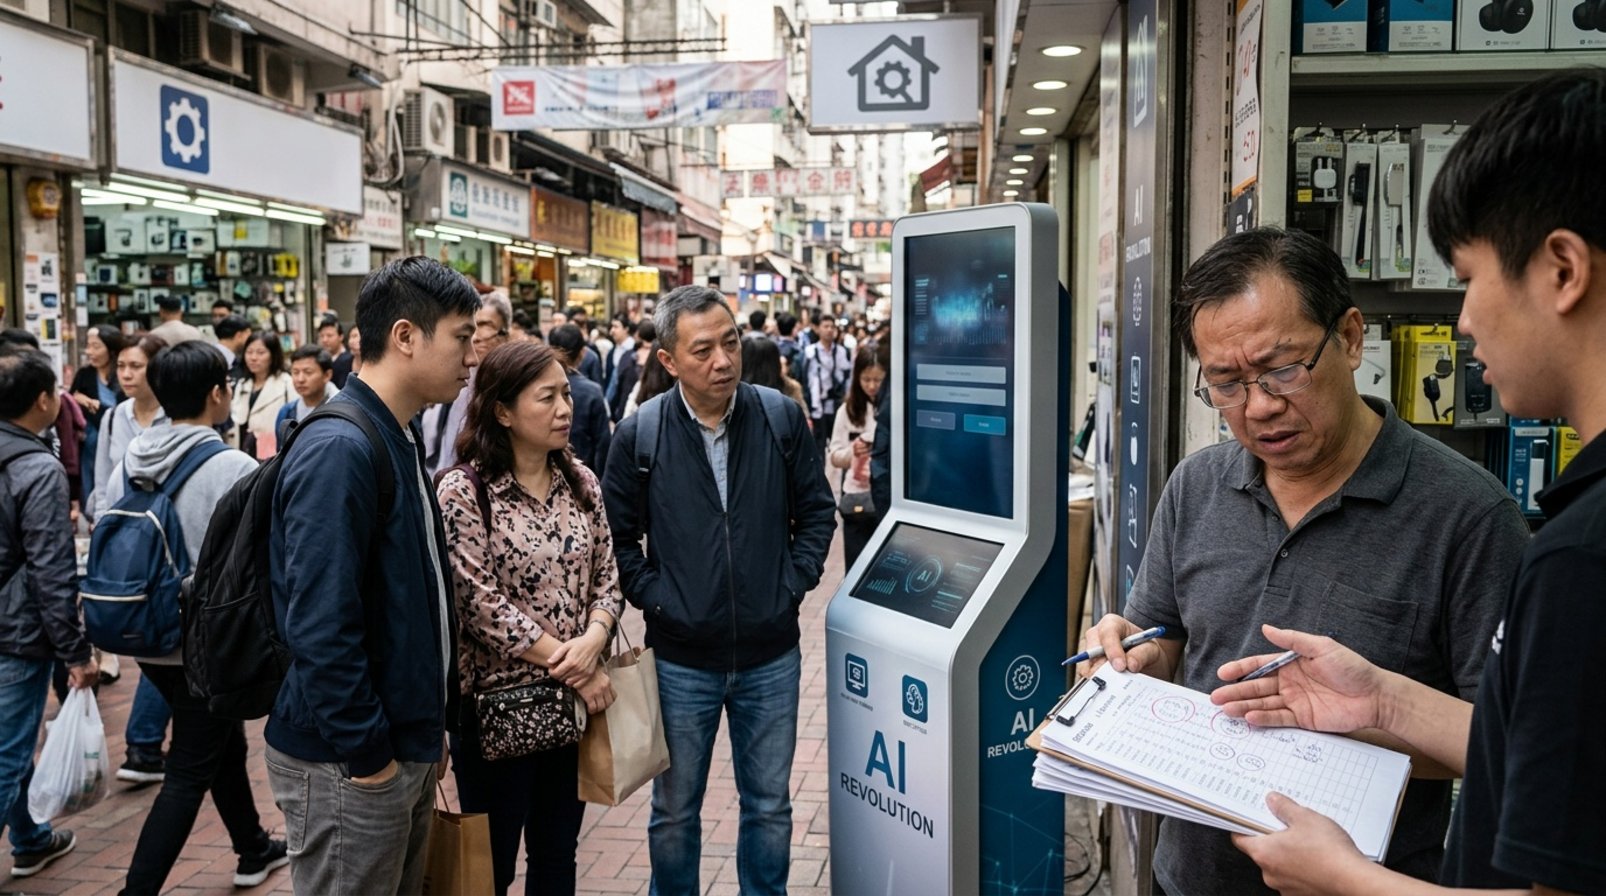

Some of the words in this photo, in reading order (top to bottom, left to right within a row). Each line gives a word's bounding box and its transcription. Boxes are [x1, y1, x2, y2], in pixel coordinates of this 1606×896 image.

[1133, 184, 1144, 226] AI
[916, 569, 933, 582] AI
[1010, 707, 1035, 736] AI
[865, 729, 906, 795] AI
[840, 771, 934, 839] REVOLUTION
